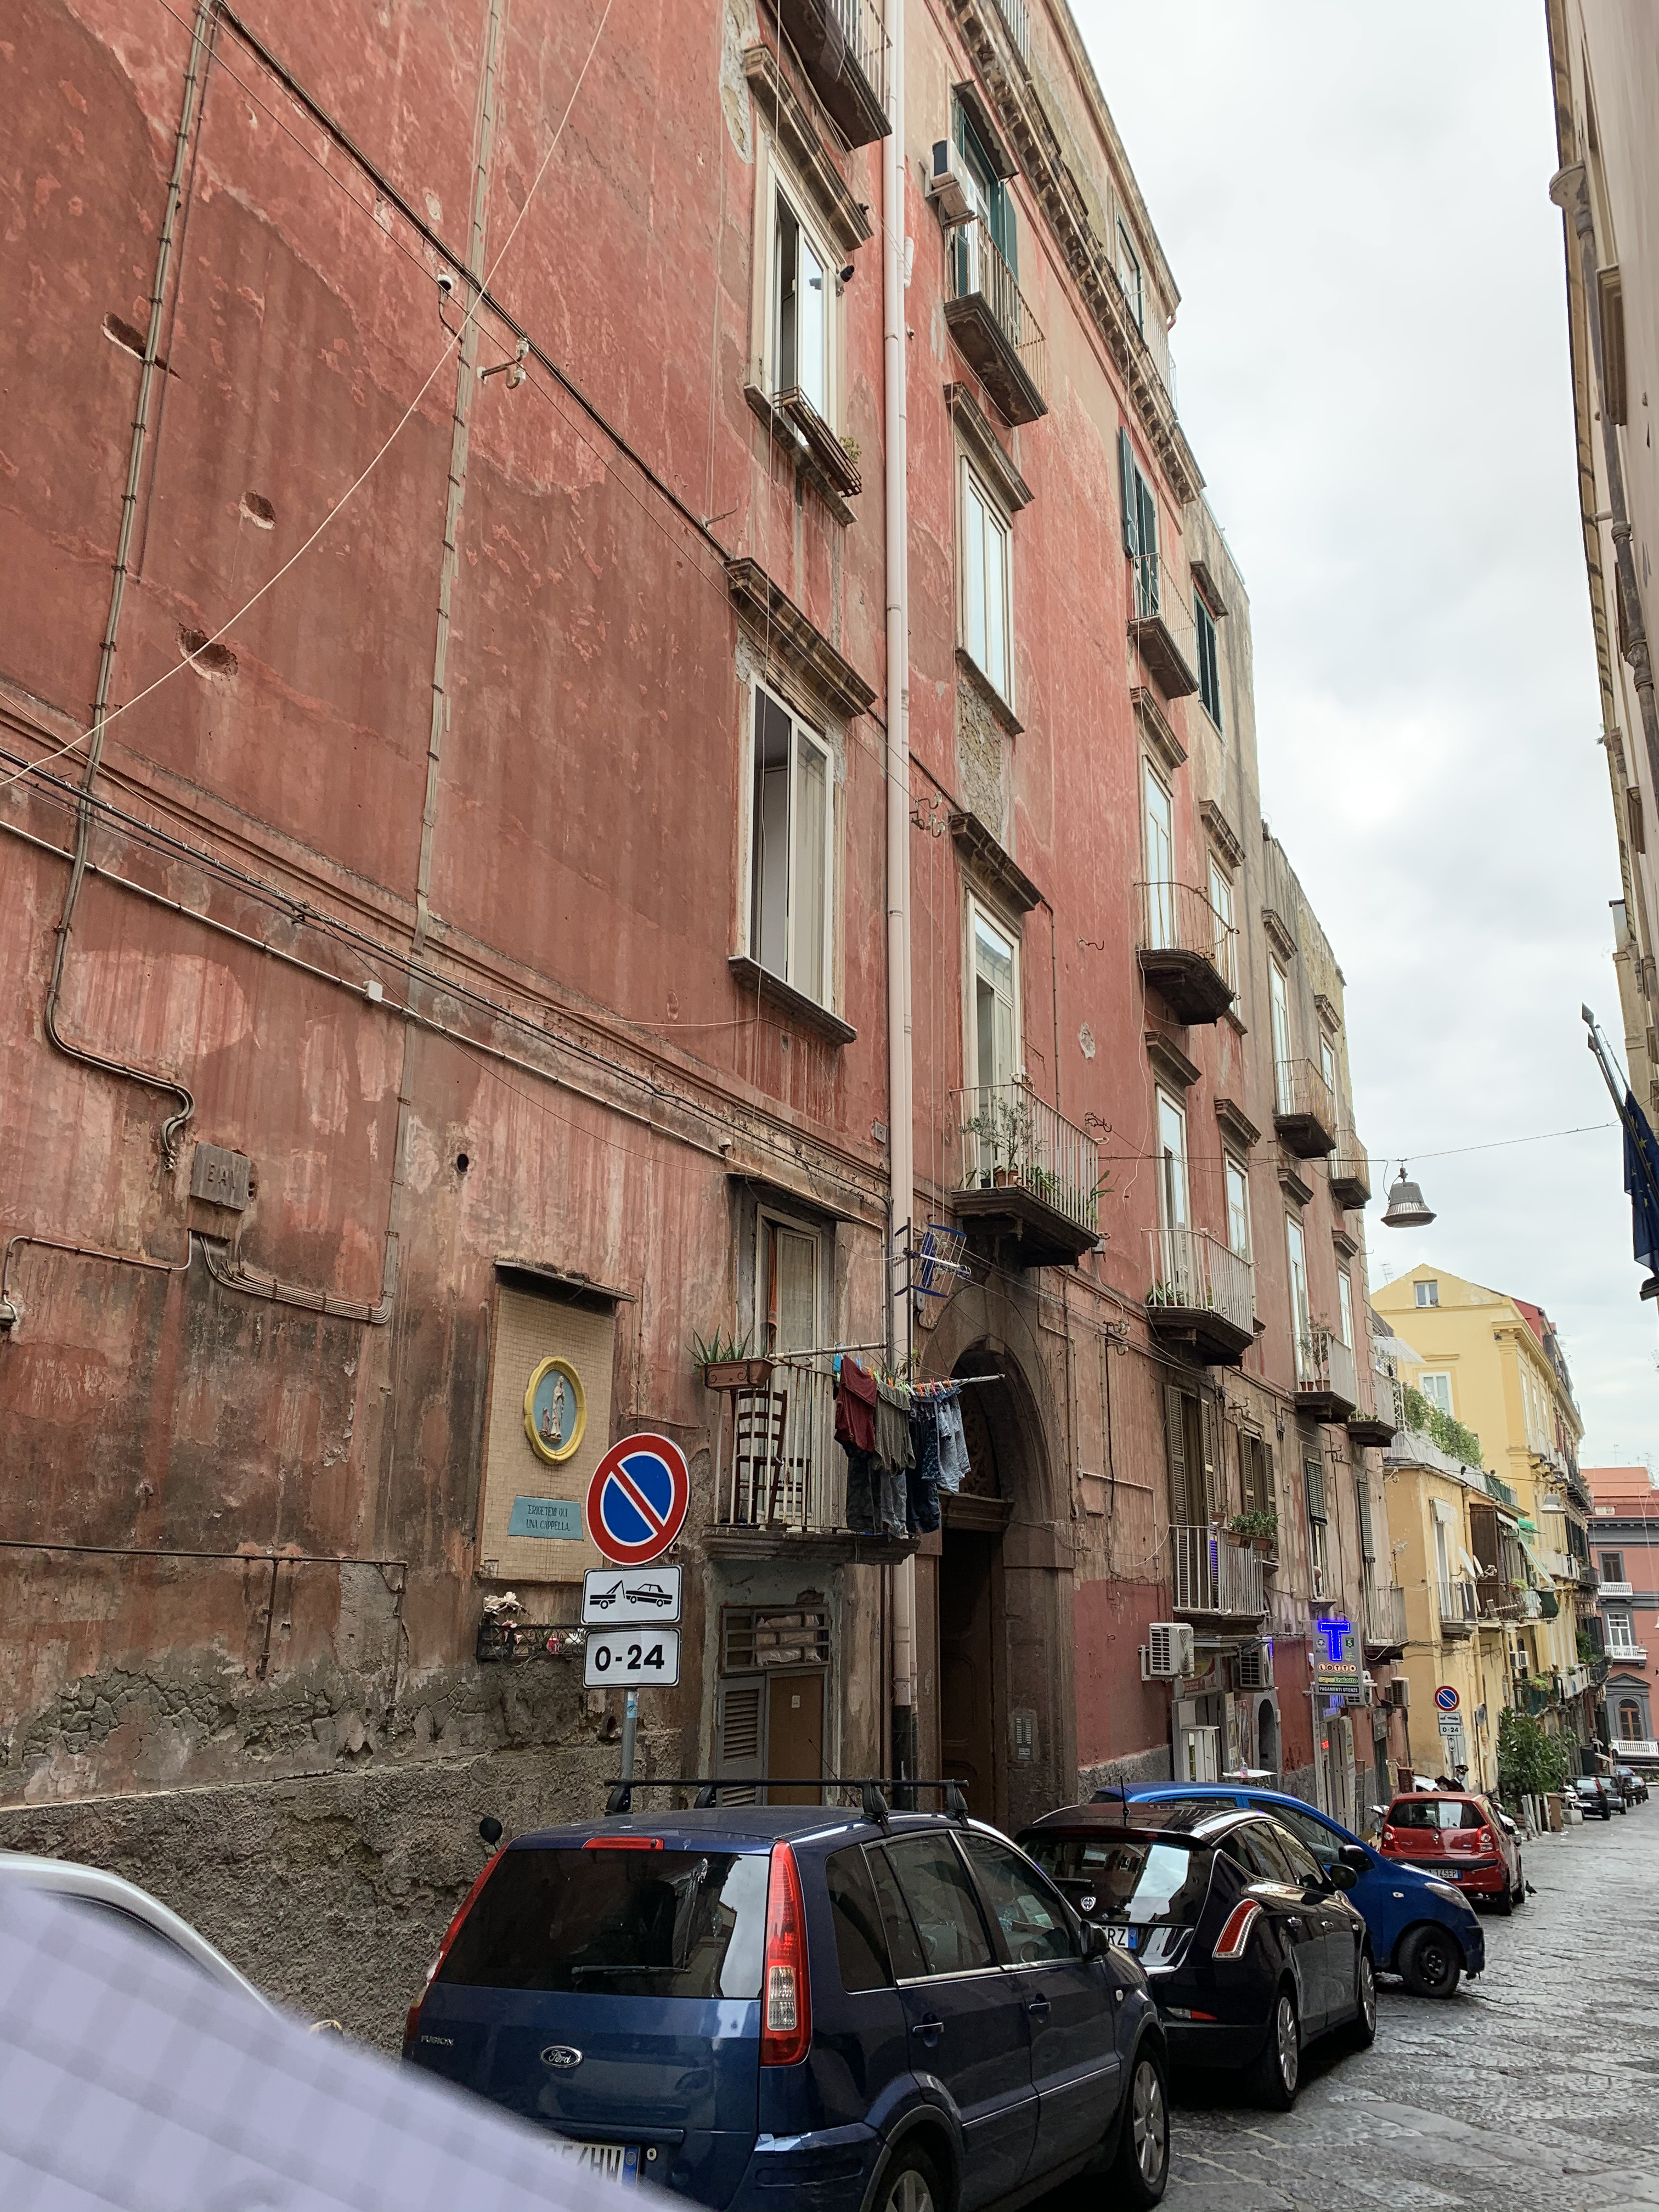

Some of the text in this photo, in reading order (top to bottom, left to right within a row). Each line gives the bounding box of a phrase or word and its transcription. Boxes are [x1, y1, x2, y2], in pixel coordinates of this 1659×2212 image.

[559, 1508, 568, 1517] QUI
[526, 1519, 538, 1529] UNA
[1319, 1622, 1350, 1661] T
[595, 1644, 664, 1672] 0-24
[1319, 1664, 1356, 1672] LOTTO
[1102, 1926, 1126, 1946] RZ
[549, 2050, 572, 2063] Ford
